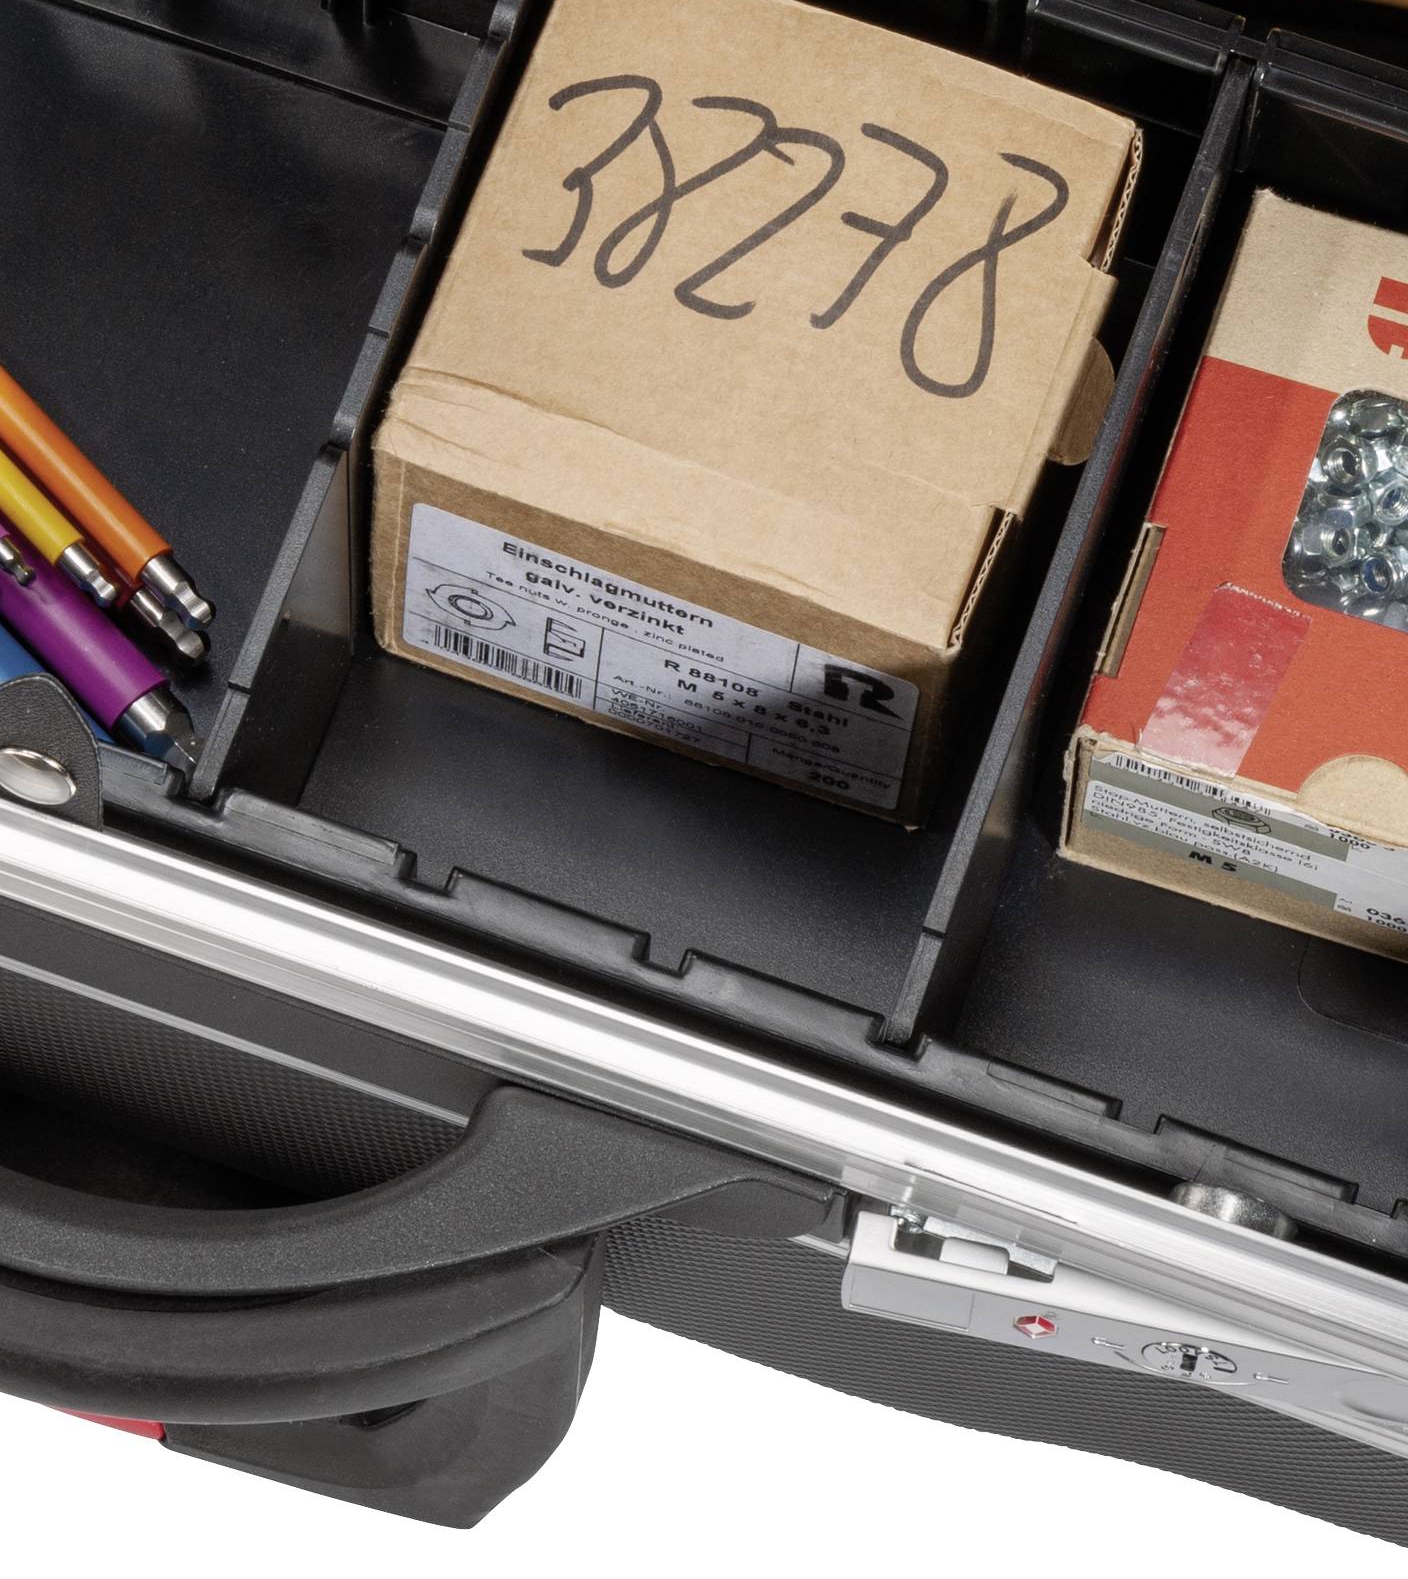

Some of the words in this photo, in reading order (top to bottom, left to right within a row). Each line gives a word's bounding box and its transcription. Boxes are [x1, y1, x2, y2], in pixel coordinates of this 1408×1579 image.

[521, 73, 1069, 399] 38278
[502, 540, 713, 628] Einschlagmuttern
[525, 569, 581, 599] galv.
[589, 592, 685, 635] verzinkt
[677, 678, 697, 693] M
[678, 641, 724, 664] plated
[663, 658, 680, 672] R
[688, 665, 759, 699] 88108
[787, 698, 848, 729] Stahl
[1188, 849, 1214, 865] M
[1220, 860, 1237, 873] 5
